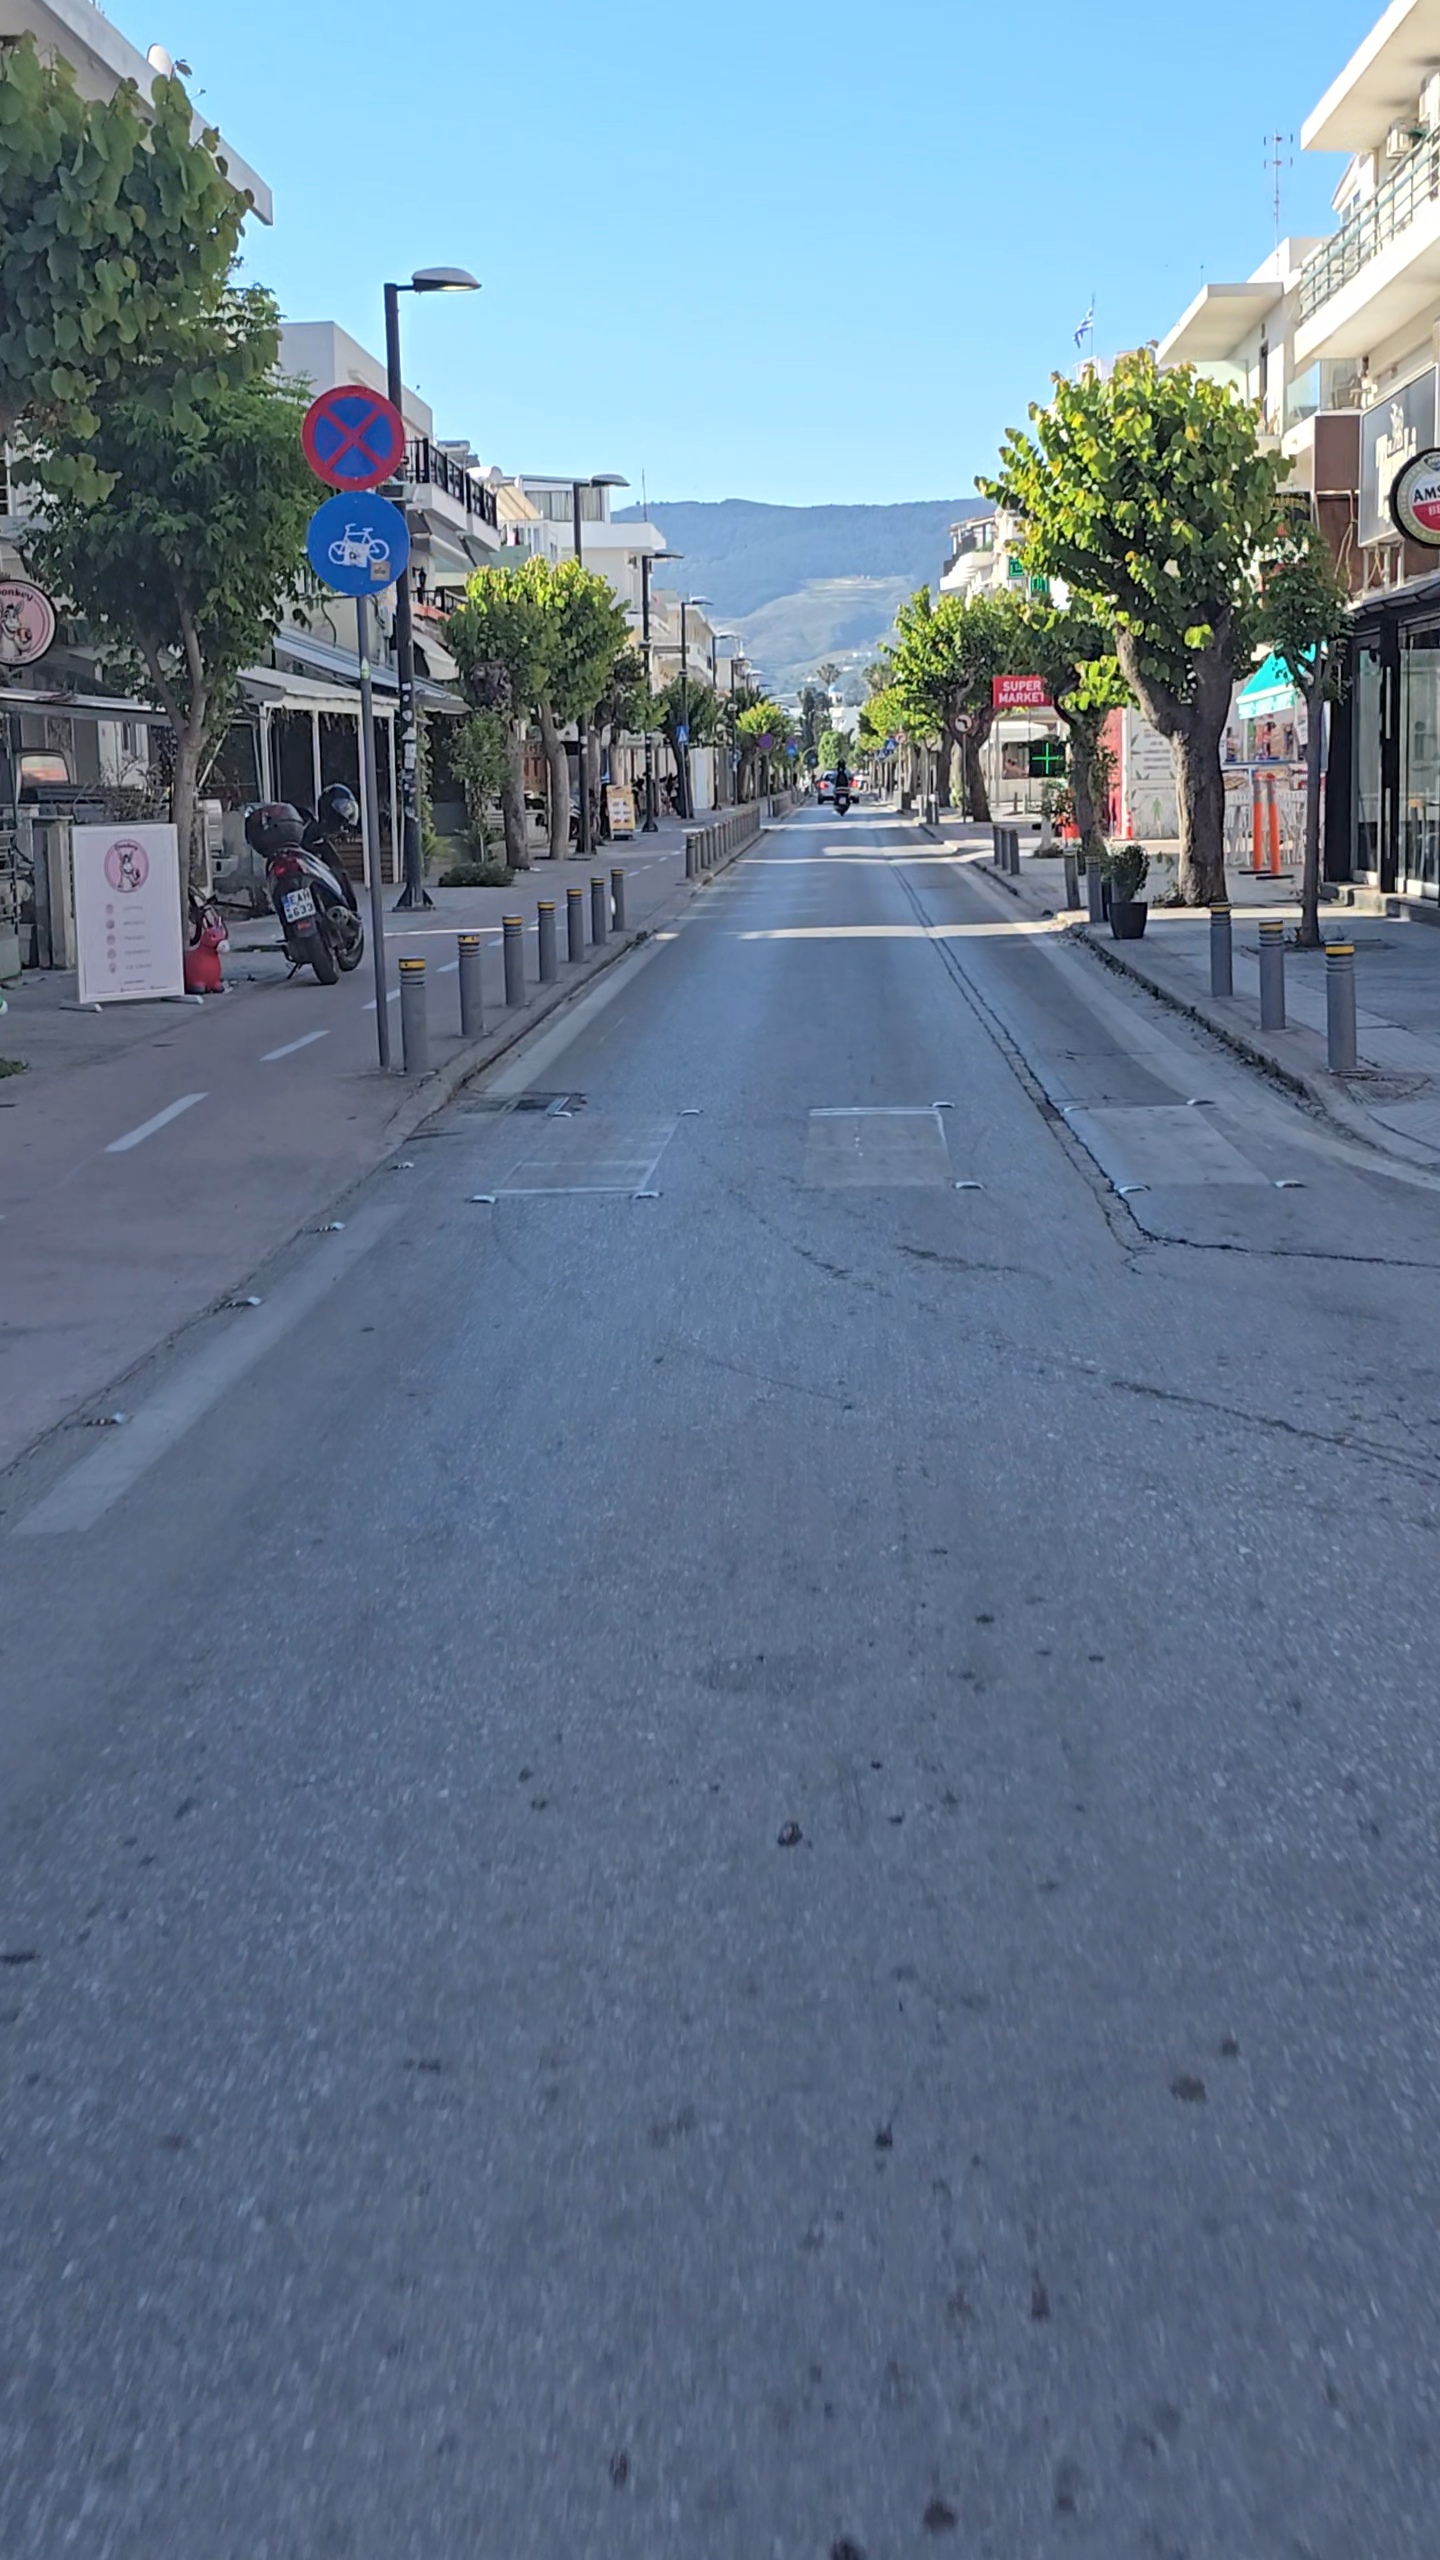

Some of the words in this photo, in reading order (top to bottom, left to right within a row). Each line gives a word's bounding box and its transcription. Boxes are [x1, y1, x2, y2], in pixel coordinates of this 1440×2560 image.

[0, 588, 34, 602] onkey
[1002, 680, 1042, 692] SUPER
[998, 691, 1045, 704] MARKET
